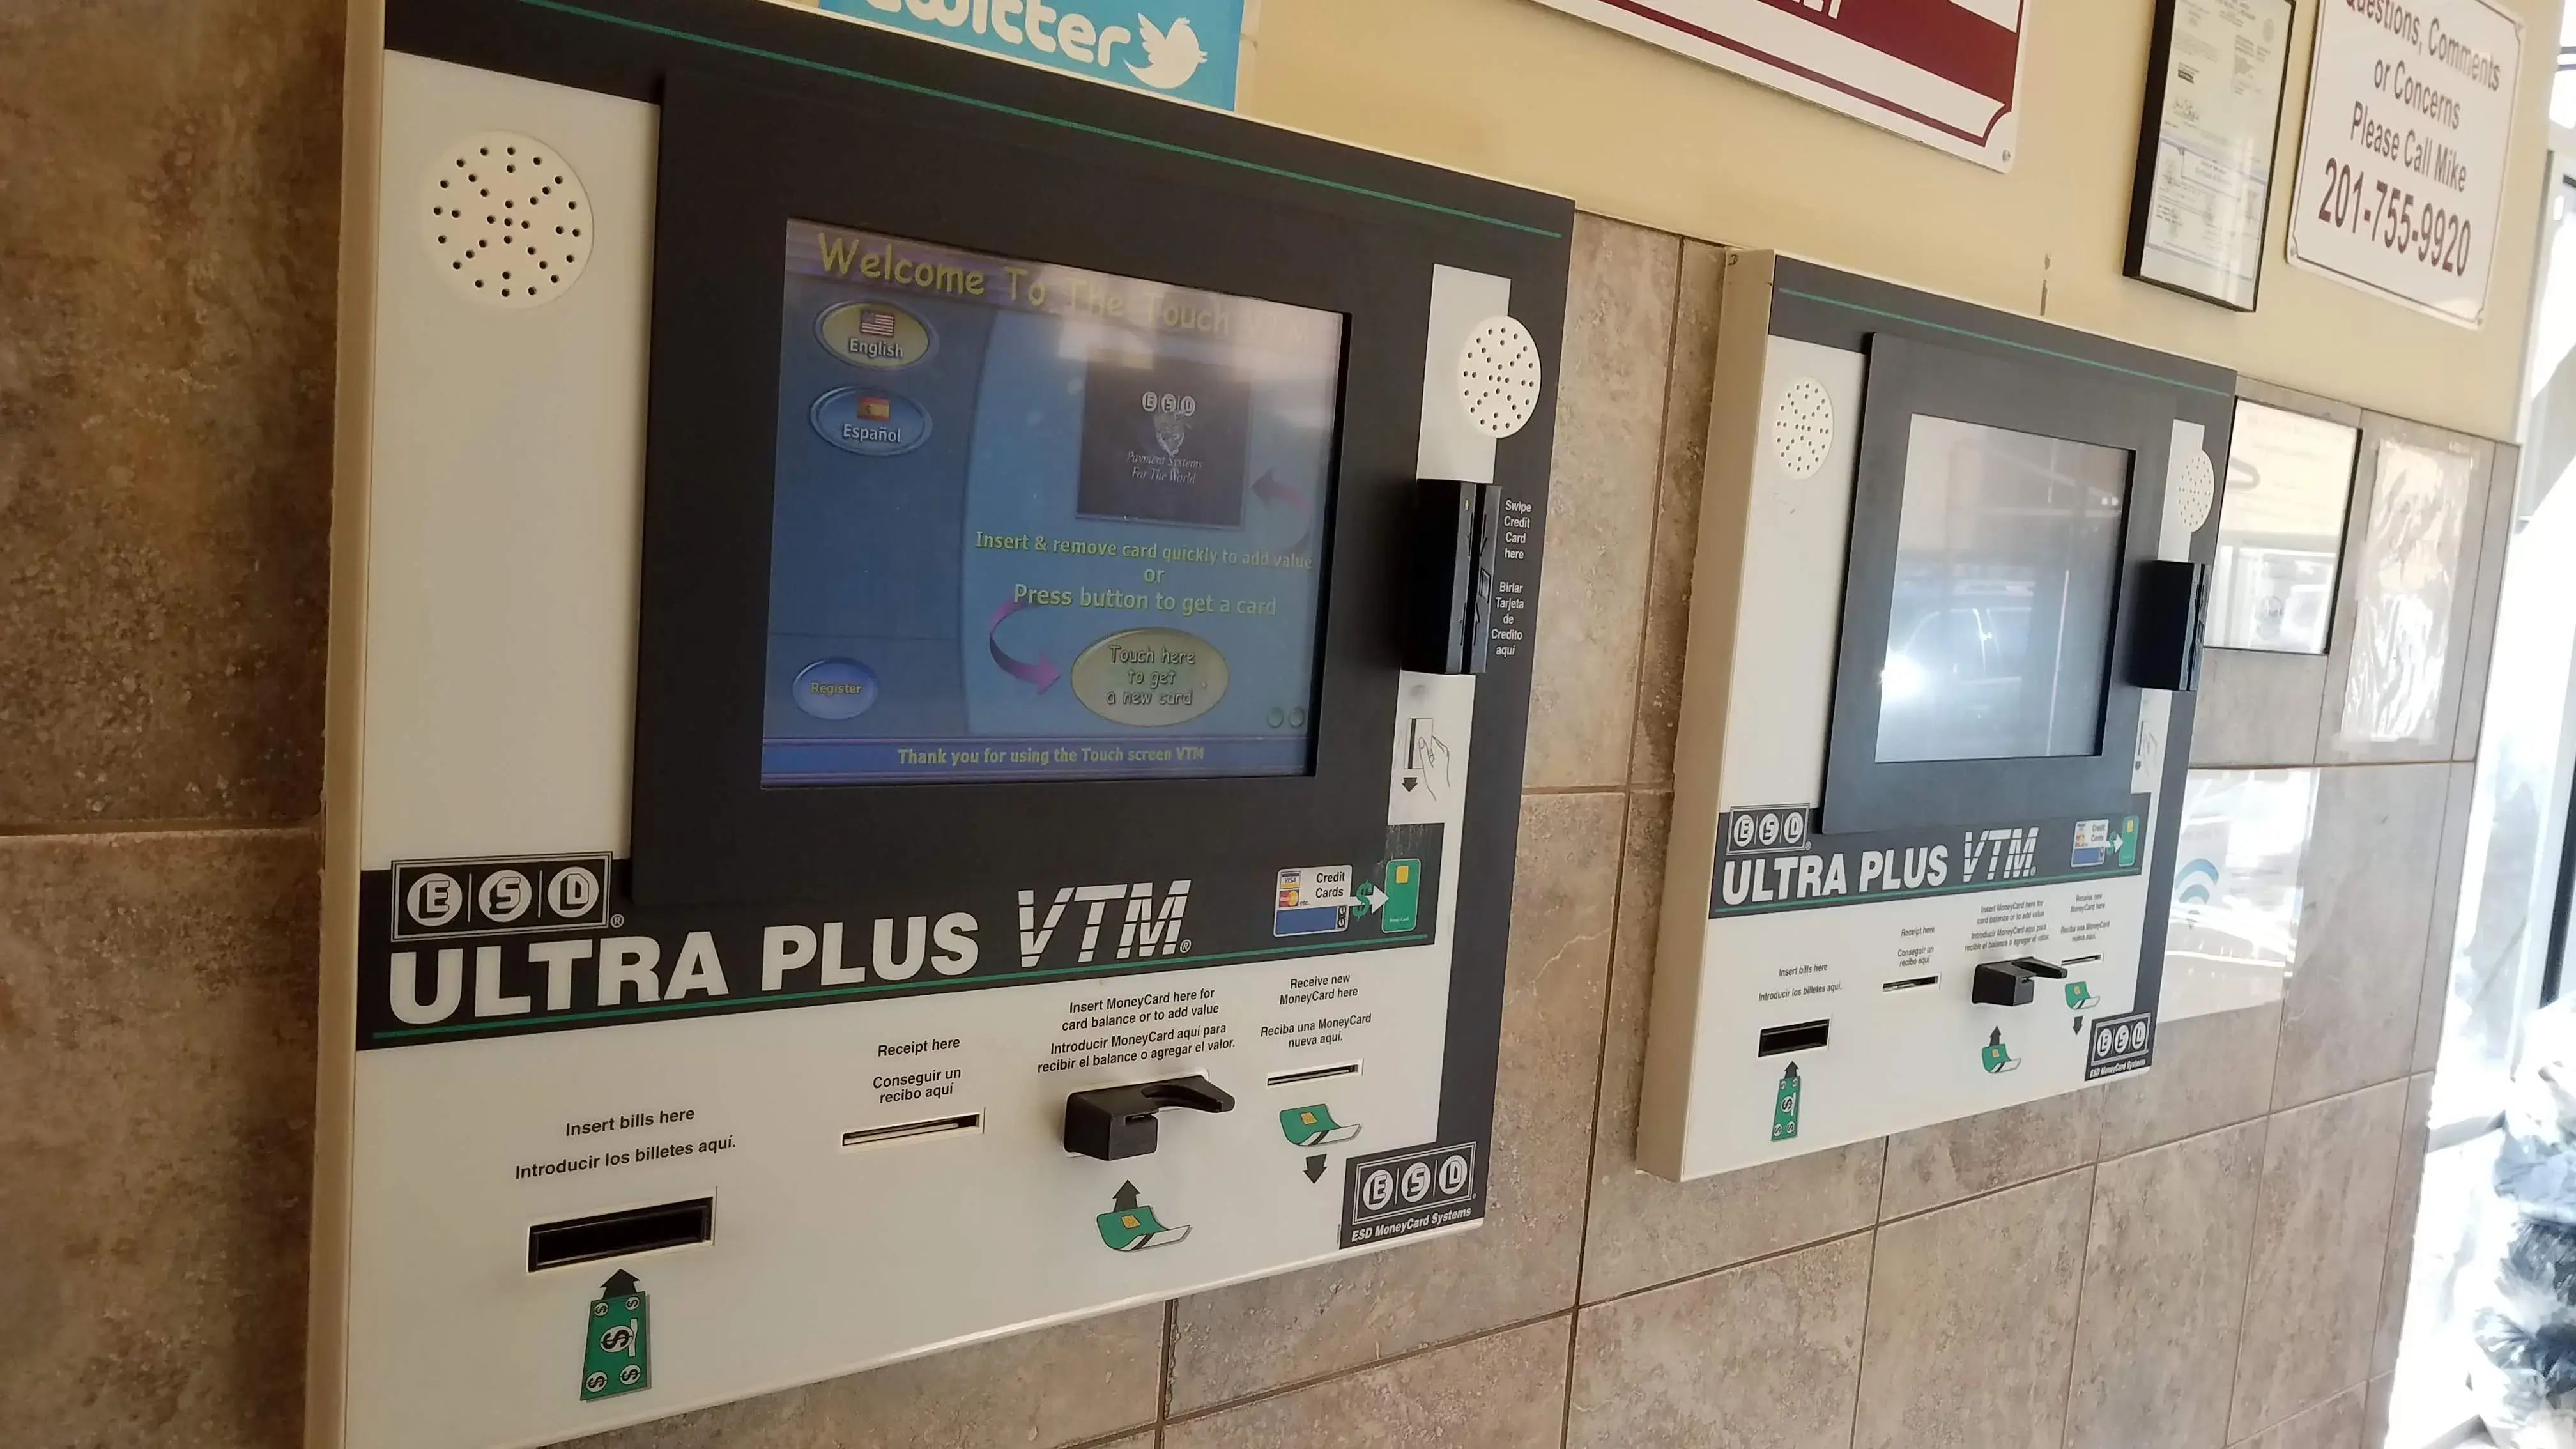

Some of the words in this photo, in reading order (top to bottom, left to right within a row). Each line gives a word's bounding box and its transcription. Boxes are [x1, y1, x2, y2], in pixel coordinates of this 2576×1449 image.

[856, 0, 1131, 66] witter
[2346, 0, 2422, 56] estions,
[2429, 17, 2500, 91] Comments
[2374, 59, 2391, 91] or
[2395, 60, 2460, 129] Concerns
[2350, 100, 2400, 161] Please
[2404, 128, 2432, 177] Call
[2434, 144, 2466, 192] Mike
[2319, 158, 2470, 276] 201-755-9920
[818, 232, 985, 295] Welcome
[1005, 267, 1046, 306] To
[1068, 277, 1124, 317] The
[1146, 291, 1229, 336] Touch
[849, 337, 903, 358] English
[843, 424, 901, 443] Español
[1128, 450, 1165, 465] Payment
[1168, 457, 1203, 470] Systems
[1131, 466, 1147, 479] For
[1151, 469, 1167, 481] The
[1170, 469, 1196, 484] World
[1505, 500, 1531, 514] Swipe
[1504, 516, 1530, 528] Credit
[1505, 532, 1526, 543] Card
[976, 531, 1029, 551] Insert
[1035, 535, 1048, 553] &
[1053, 539, 1117, 558] remove
[1123, 542, 1157, 559] card
[1163, 547, 1217, 565] quickly
[1222, 550, 1237, 565] to
[1242, 551, 1269, 567] add
[1274, 555, 1313, 570] value
[1505, 548, 1524, 559] here
[1144, 568, 1165, 584] or
[1499, 581, 1524, 594] Birlar
[1014, 584, 1072, 606] Press
[1080, 587, 1148, 611] button
[1155, 590, 1176, 611] to
[1182, 594, 1214, 616] get
[1220, 599, 1230, 613] a
[1237, 596, 1276, 616] card
[1495, 597, 1524, 611] Tarjeta
[1503, 613, 1514, 624] de
[1491, 629, 1523, 640] Credito
[1110, 645, 1154, 664] Touch
[1162, 647, 1195, 666] here
[811, 682, 862, 697] Register
[1128, 670, 1144, 685] to
[1150, 671, 1176, 690] get
[1106, 691, 1116, 705] a
[1124, 692, 1152, 705] new
[1160, 689, 1192, 706] card
[898, 748, 947, 764] Thank
[951, 751, 979, 767] you
[984, 748, 1006, 764] for
[1011, 749, 1048, 765] using
[1054, 747, 1077, 762] the
[1082, 747, 1123, 761] Touch
[1128, 749, 1171, 761] screen
[1177, 747, 1204, 760] VTM
[1722, 853, 1846, 905] ULTRA
[1859, 845, 1948, 892] PLUS
[1963, 827, 2039, 882] VTM
[1316, 871, 1346, 884] Credit
[1315, 887, 1344, 898] Cards
[1901, 927, 1922, 937] Receipt
[390, 931, 729, 1025] ULTRA
[762, 912, 979, 991] PLUS
[1018, 880, 1191, 968] VTM
[1898, 946, 1926, 957] Conseguir
[1779, 968, 1797, 976] Insert
[1799, 965, 1812, 974] bills
[1814, 963, 1828, 972] here
[1290, 976, 1328, 989] Receive
[1331, 974, 1351, 984] new
[1070, 1000, 1103, 1013] Insert
[1107, 992, 1170, 1009] MoneyCard
[1173, 991, 1197, 1002] here
[1200, 988, 1215, 999] for
[1280, 988, 1335, 1005] MoneyCard
[1337, 987, 1358, 998] here
[1758, 989, 1790, 1001] Introducir
[1792, 988, 1801, 996] los
[1803, 985, 1825, 995] billetes
[1062, 1018, 1087, 1031] card
[1091, 1012, 1135, 1027] balance
[1139, 1012, 1151, 1022] or
[1154, 1010, 1164, 1020] to
[1168, 1007, 1187, 1018] add
[1191, 1004, 1219, 1016] value
[1261, 1024, 1294, 1037] Reciba
[1298, 1022, 1315, 1032] una
[1319, 1013, 1372, 1029] MoneyCard
[878, 1041, 928, 1057] Receipt
[932, 1038, 960, 1051] here
[1051, 1038, 1108, 1054] Introducir
[1112, 1029, 1174, 1047] MoneyCard
[1177, 1025, 1200, 1040] aquí
[1203, 1024, 1226, 1038] para
[1289, 1037, 1317, 1048] nueva
[1320, 1031, 1343, 1045] aquí.
[1038, 1058, 1076, 1073] recibir
[1079, 1056, 1089, 1067] el
[1093, 1051, 1137, 1066] balance
[1140, 1051, 1147, 1059] o
[1151, 1044, 1192, 1061] agregar
[1195, 1041, 1204, 1052] el
[1208, 1038, 1235, 1050] valor.
[873, 1070, 941, 1089] Conseguir
[946, 1069, 961, 1079] un
[880, 1088, 921, 1103] recibo
[925, 1082, 954, 1099] aquí
[565, 1117, 615, 1136] Insert
[620, 1114, 654, 1130] bills
[659, 1109, 695, 1124] here
[516, 1155, 600, 1179] Introducir
[606, 1153, 630, 1167] los
[636, 1142, 693, 1162] billetes
[698, 1135, 736, 1154] aquí.
[1351, 1227, 1372, 1242] ESD
[1375, 1215, 1430, 1238] MoneyCard
[1431, 1208, 1471, 1225] Systems
